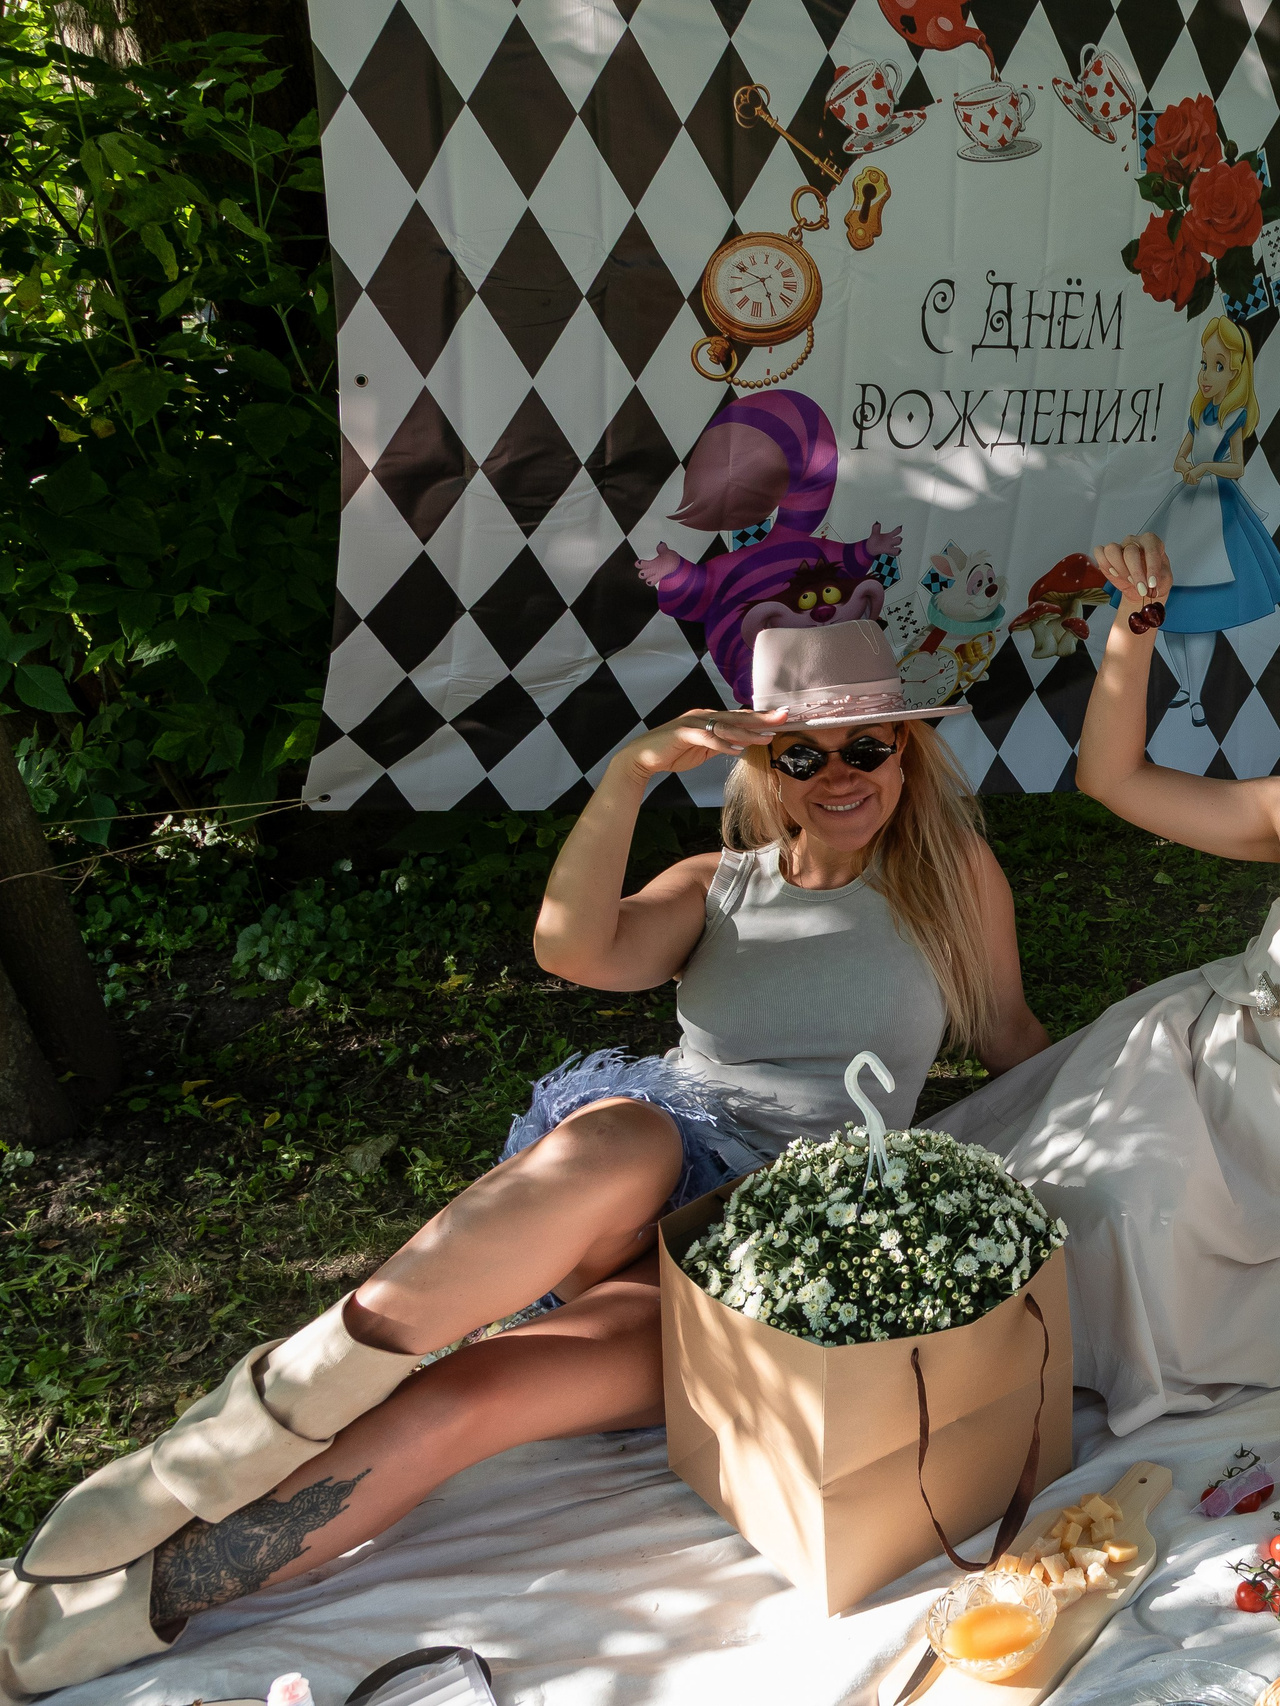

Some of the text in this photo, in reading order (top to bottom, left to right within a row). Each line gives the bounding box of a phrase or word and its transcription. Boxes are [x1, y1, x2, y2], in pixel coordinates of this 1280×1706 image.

[921, 269, 1125, 363] С ДНЁМ
[850, 382, 1165, 458] РОЖДЕНИЯ!
